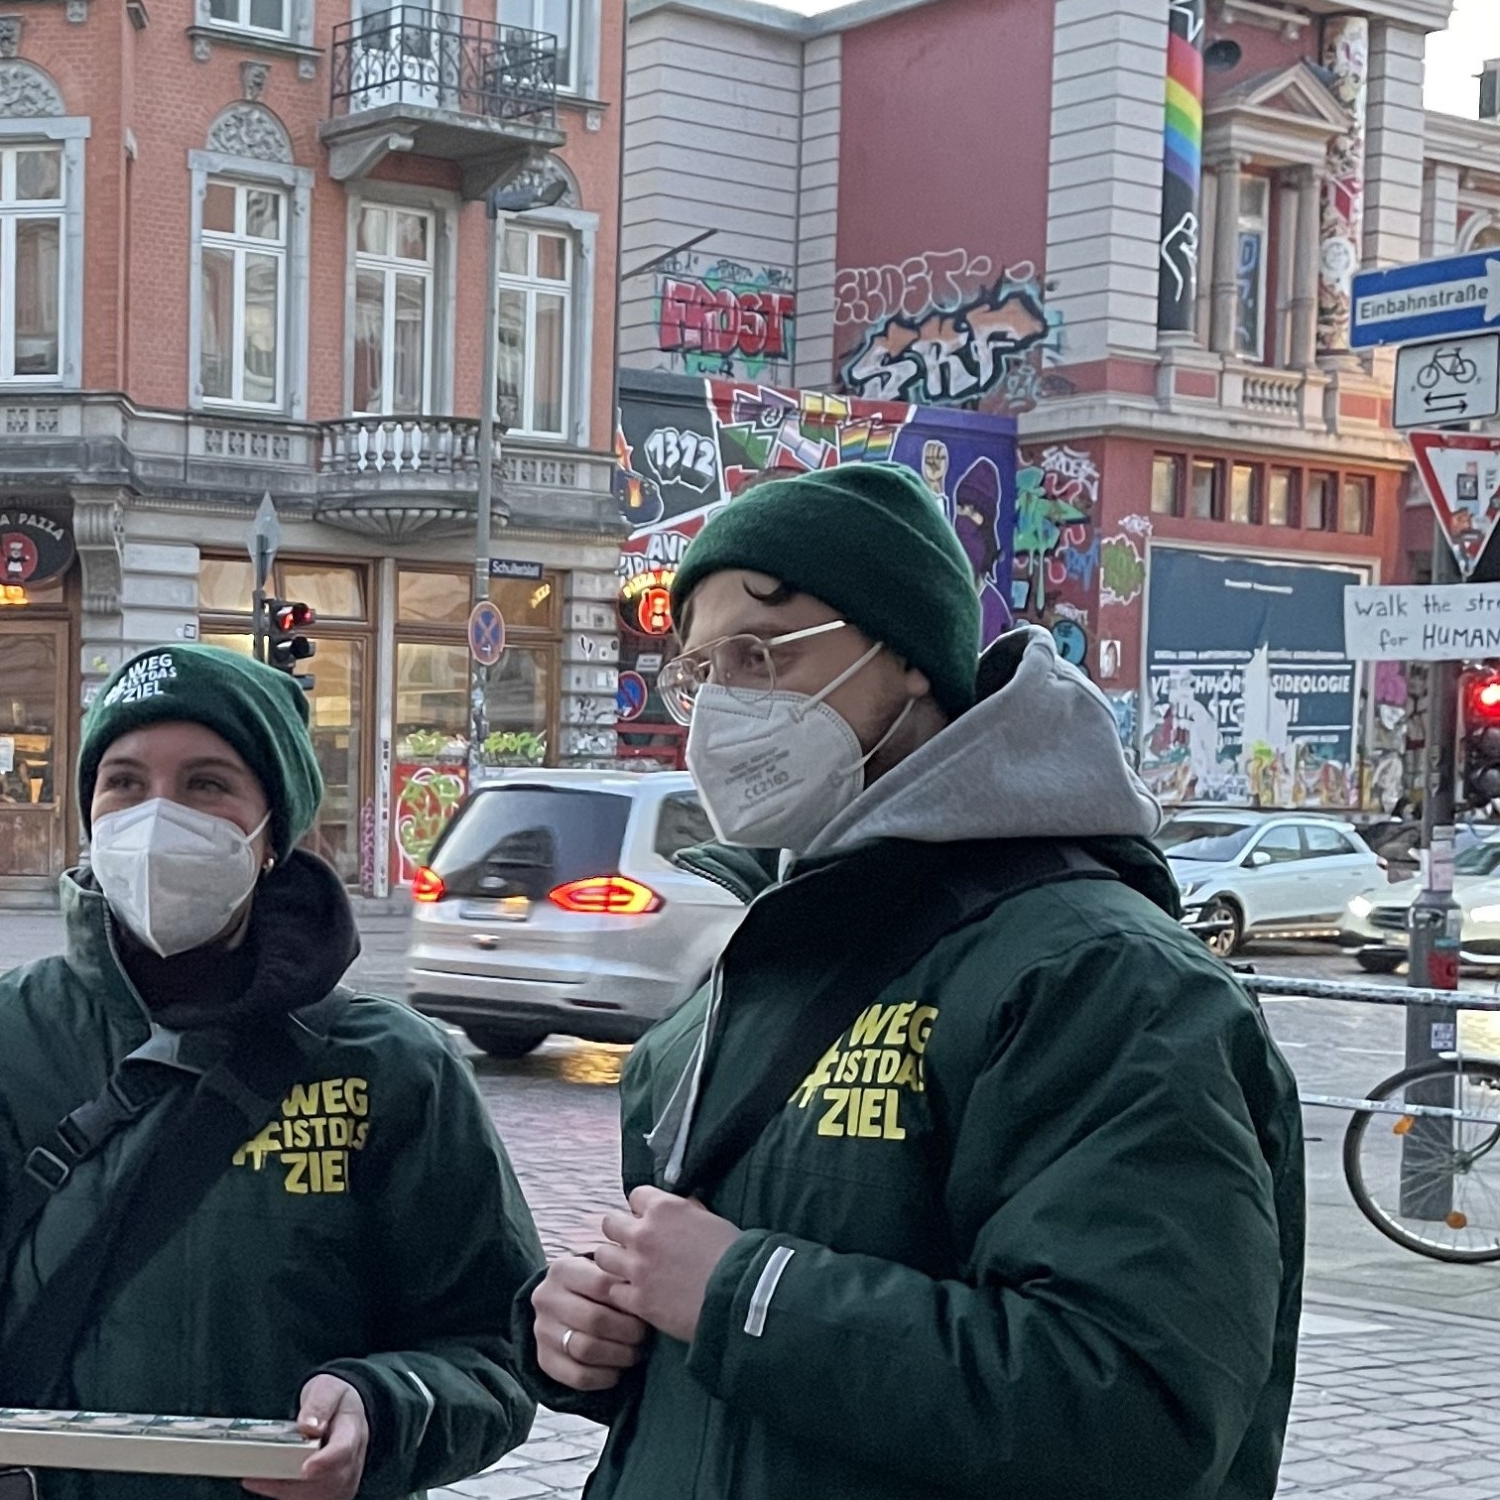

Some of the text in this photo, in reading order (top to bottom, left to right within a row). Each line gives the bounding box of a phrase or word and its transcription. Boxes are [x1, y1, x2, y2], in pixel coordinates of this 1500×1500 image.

[1360, 284, 1489, 320] Einbahnstraße
[646, 432, 716, 480] 1312
[18, 513, 65, 541] PAZZA
[1423, 593, 1452, 614] the
[1465, 592, 1500, 612] str
[1379, 628, 1409, 652] for
[128, 653, 173, 679] WEG
[122, 680, 164, 703] ZIEL
[848, 1000, 939, 1055] WEG
[281, 1077, 368, 1117] WEG
[817, 1087, 906, 1140] ZIEL
[280, 1150, 350, 1194] ZIE
